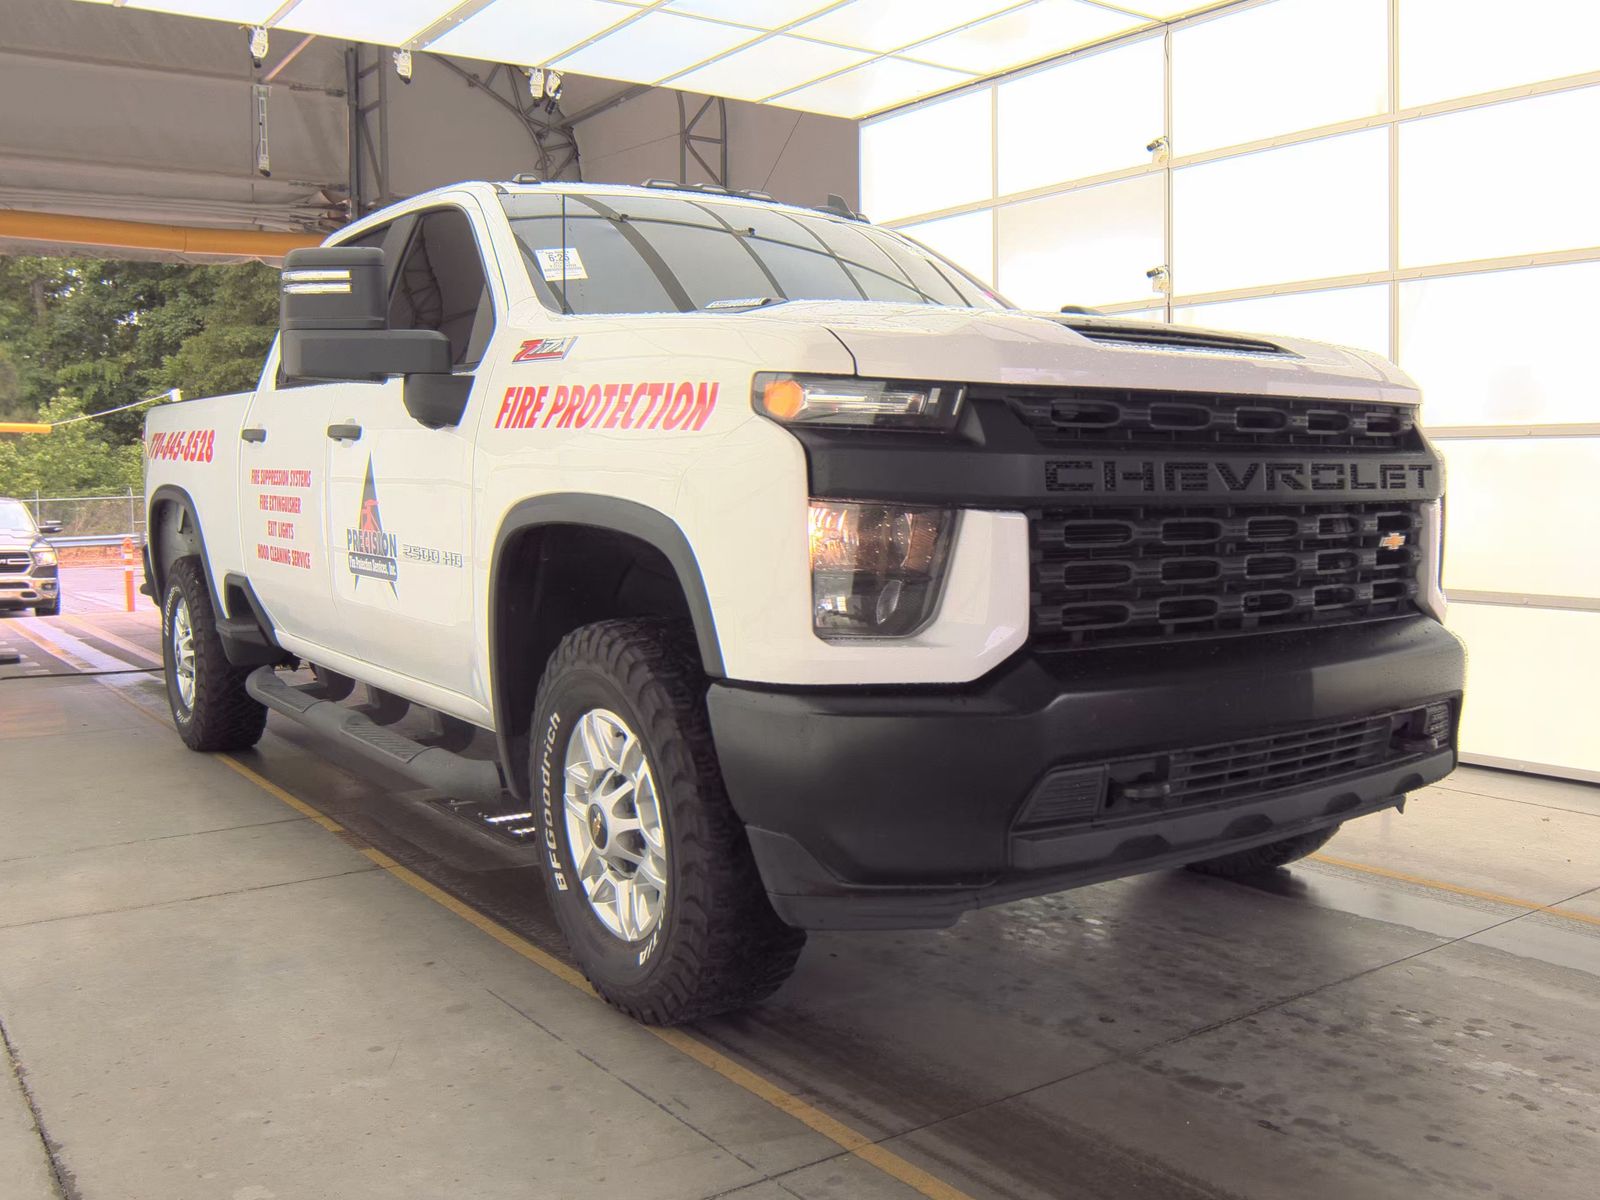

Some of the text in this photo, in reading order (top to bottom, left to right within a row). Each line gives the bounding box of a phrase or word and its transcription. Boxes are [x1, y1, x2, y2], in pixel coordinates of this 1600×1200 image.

[494, 381, 720, 431] FIRE PROTECTION
[149, 430, 215, 463] 770-845-8528
[251, 469, 311, 487] FIRE SUPPRESSION SYSTEMS
[1044, 459, 1433, 493] CHEVROLET
[259, 494, 269, 510] FIRE
[267, 520, 294, 539] EXIT LIGHTS
[346, 528, 398, 558] PRECISION
[257, 543, 311, 569] HOOD CLEANING SERVICE
[402, 544, 463, 568] 2500 HD
[541, 711, 569, 891] BFGoodrich
